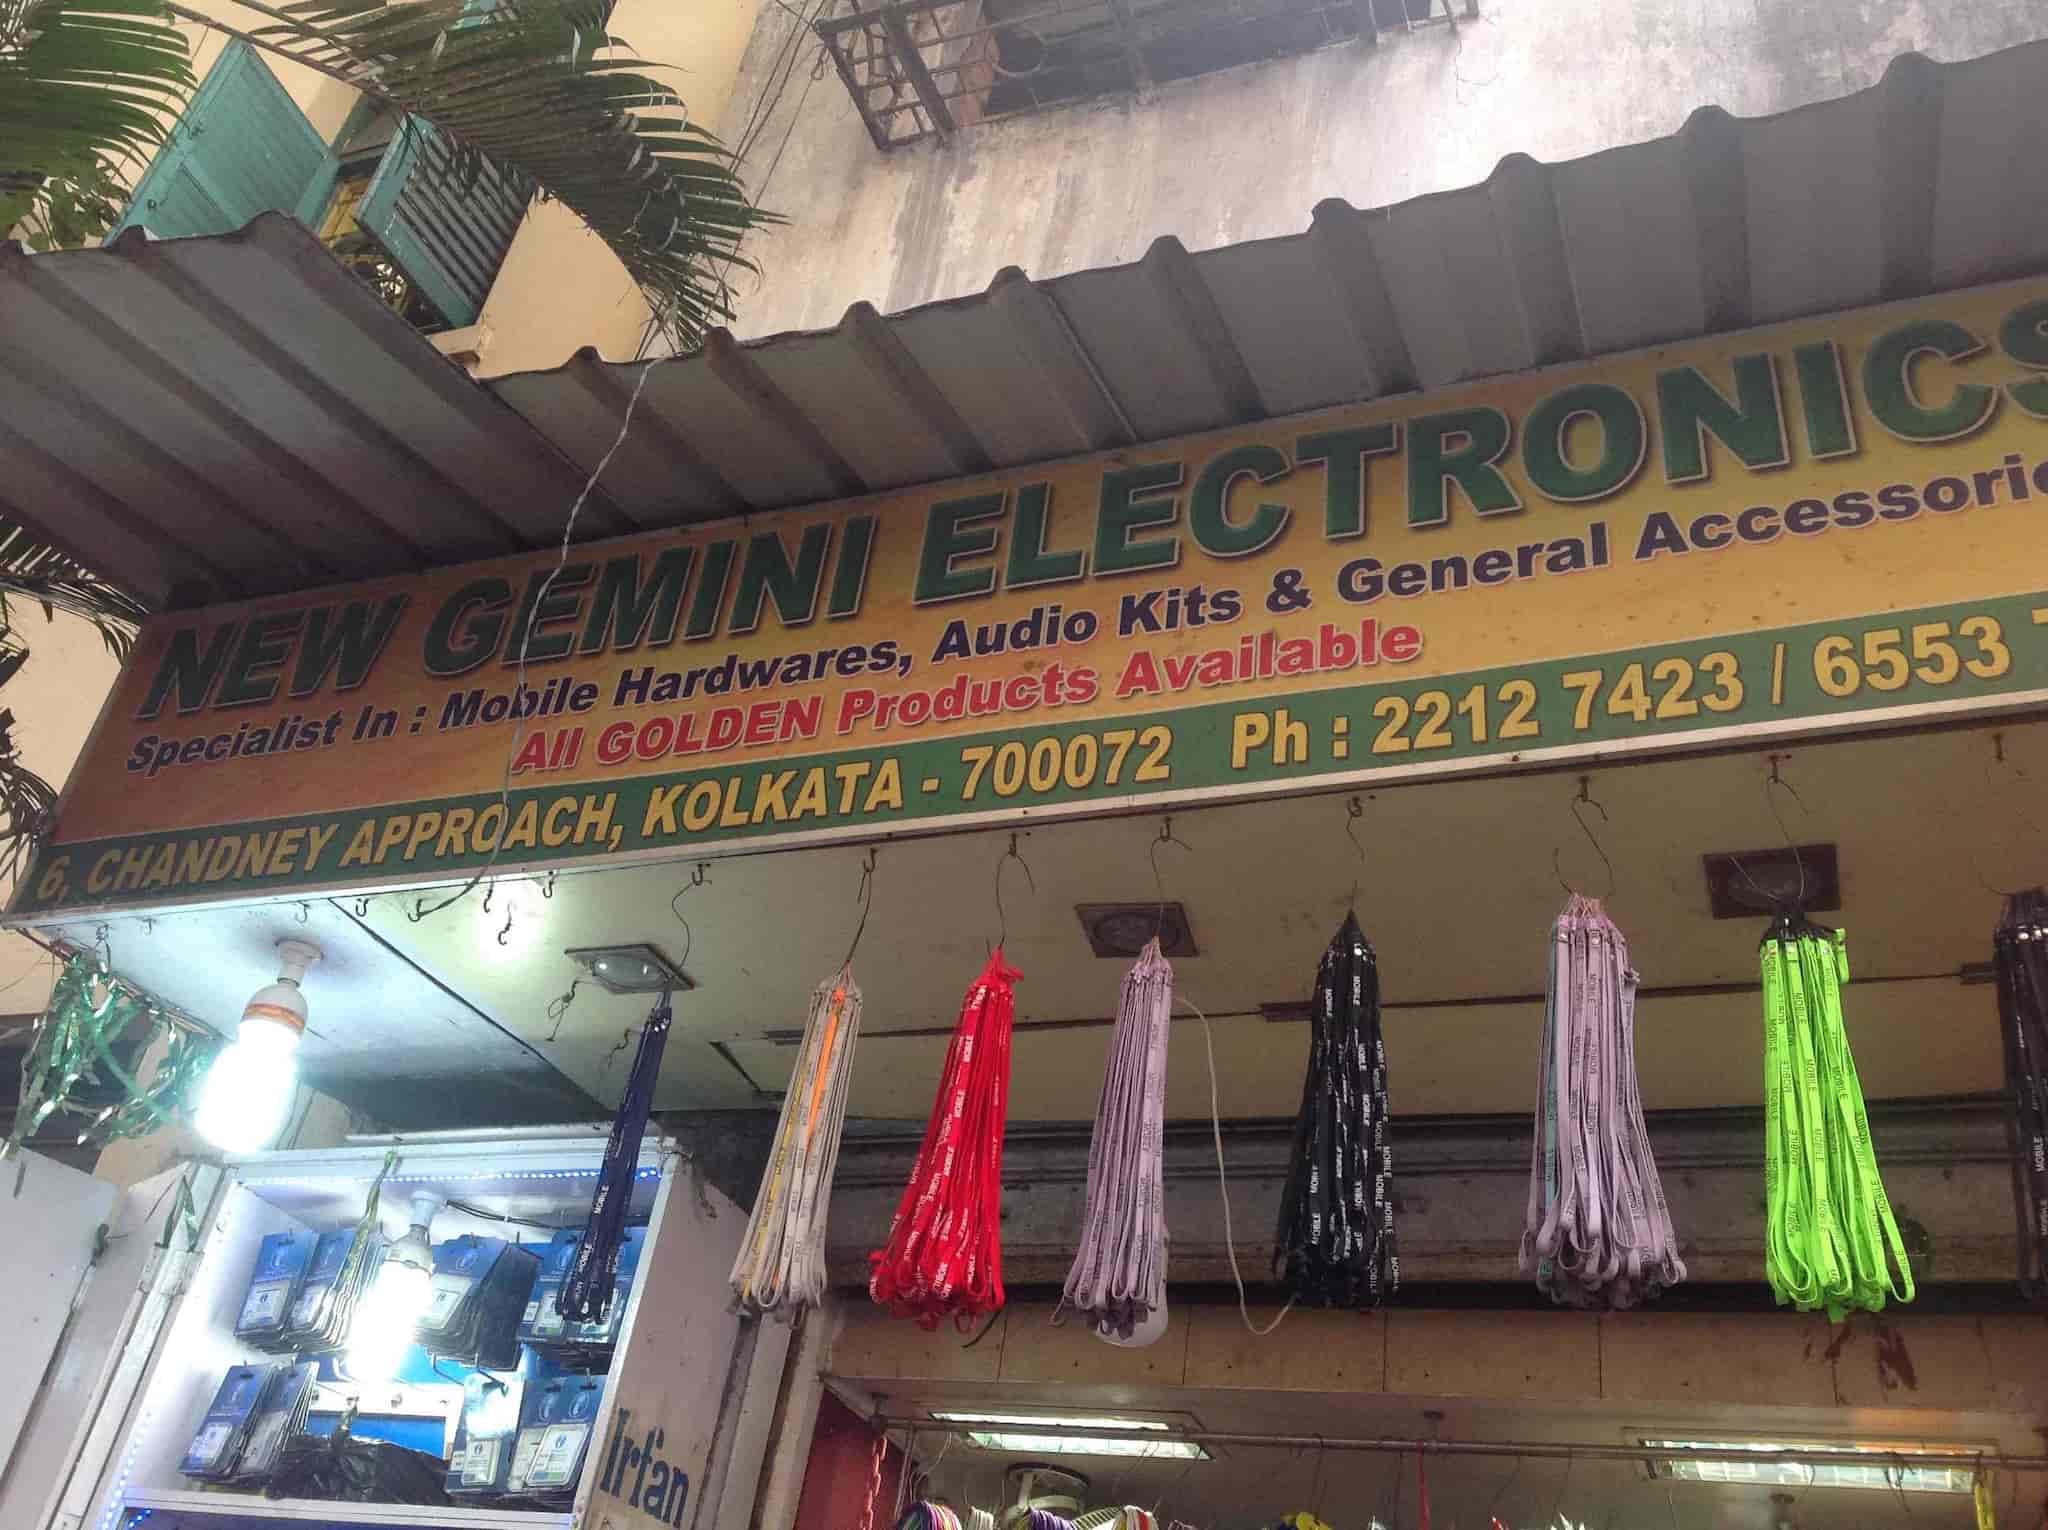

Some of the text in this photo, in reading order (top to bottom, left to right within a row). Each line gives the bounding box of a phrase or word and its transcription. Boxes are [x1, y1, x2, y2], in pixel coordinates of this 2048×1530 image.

[127, 711, 343, 777] Specialist
[352, 704, 399, 742] In
[439, 675, 599, 732] Mobile
[612, 638, 912, 707] Hardwares,
[931, 607, 1098, 664] Audio
[1117, 582, 1243, 639] Kits
[1265, 568, 1313, 613] &
[1337, 522, 1609, 603] General
[134, 593, 409, 721] NEW
[422, 511, 879, 678] GEMINI
[511, 618, 1423, 774] All GOLDEN Products Available
[86, 823, 336, 894] CHANDNEY
[339, 792, 624, 868] APPROACH,
[640, 757, 905, 838] KOLKATA
[959, 725, 1174, 796] 700072
[1231, 705, 1308, 770] Ph
[1371, 678, 1541, 754] 2212
[1561, 650, 1744, 723] 7423
[1812, 615, 2012, 698] 6553
